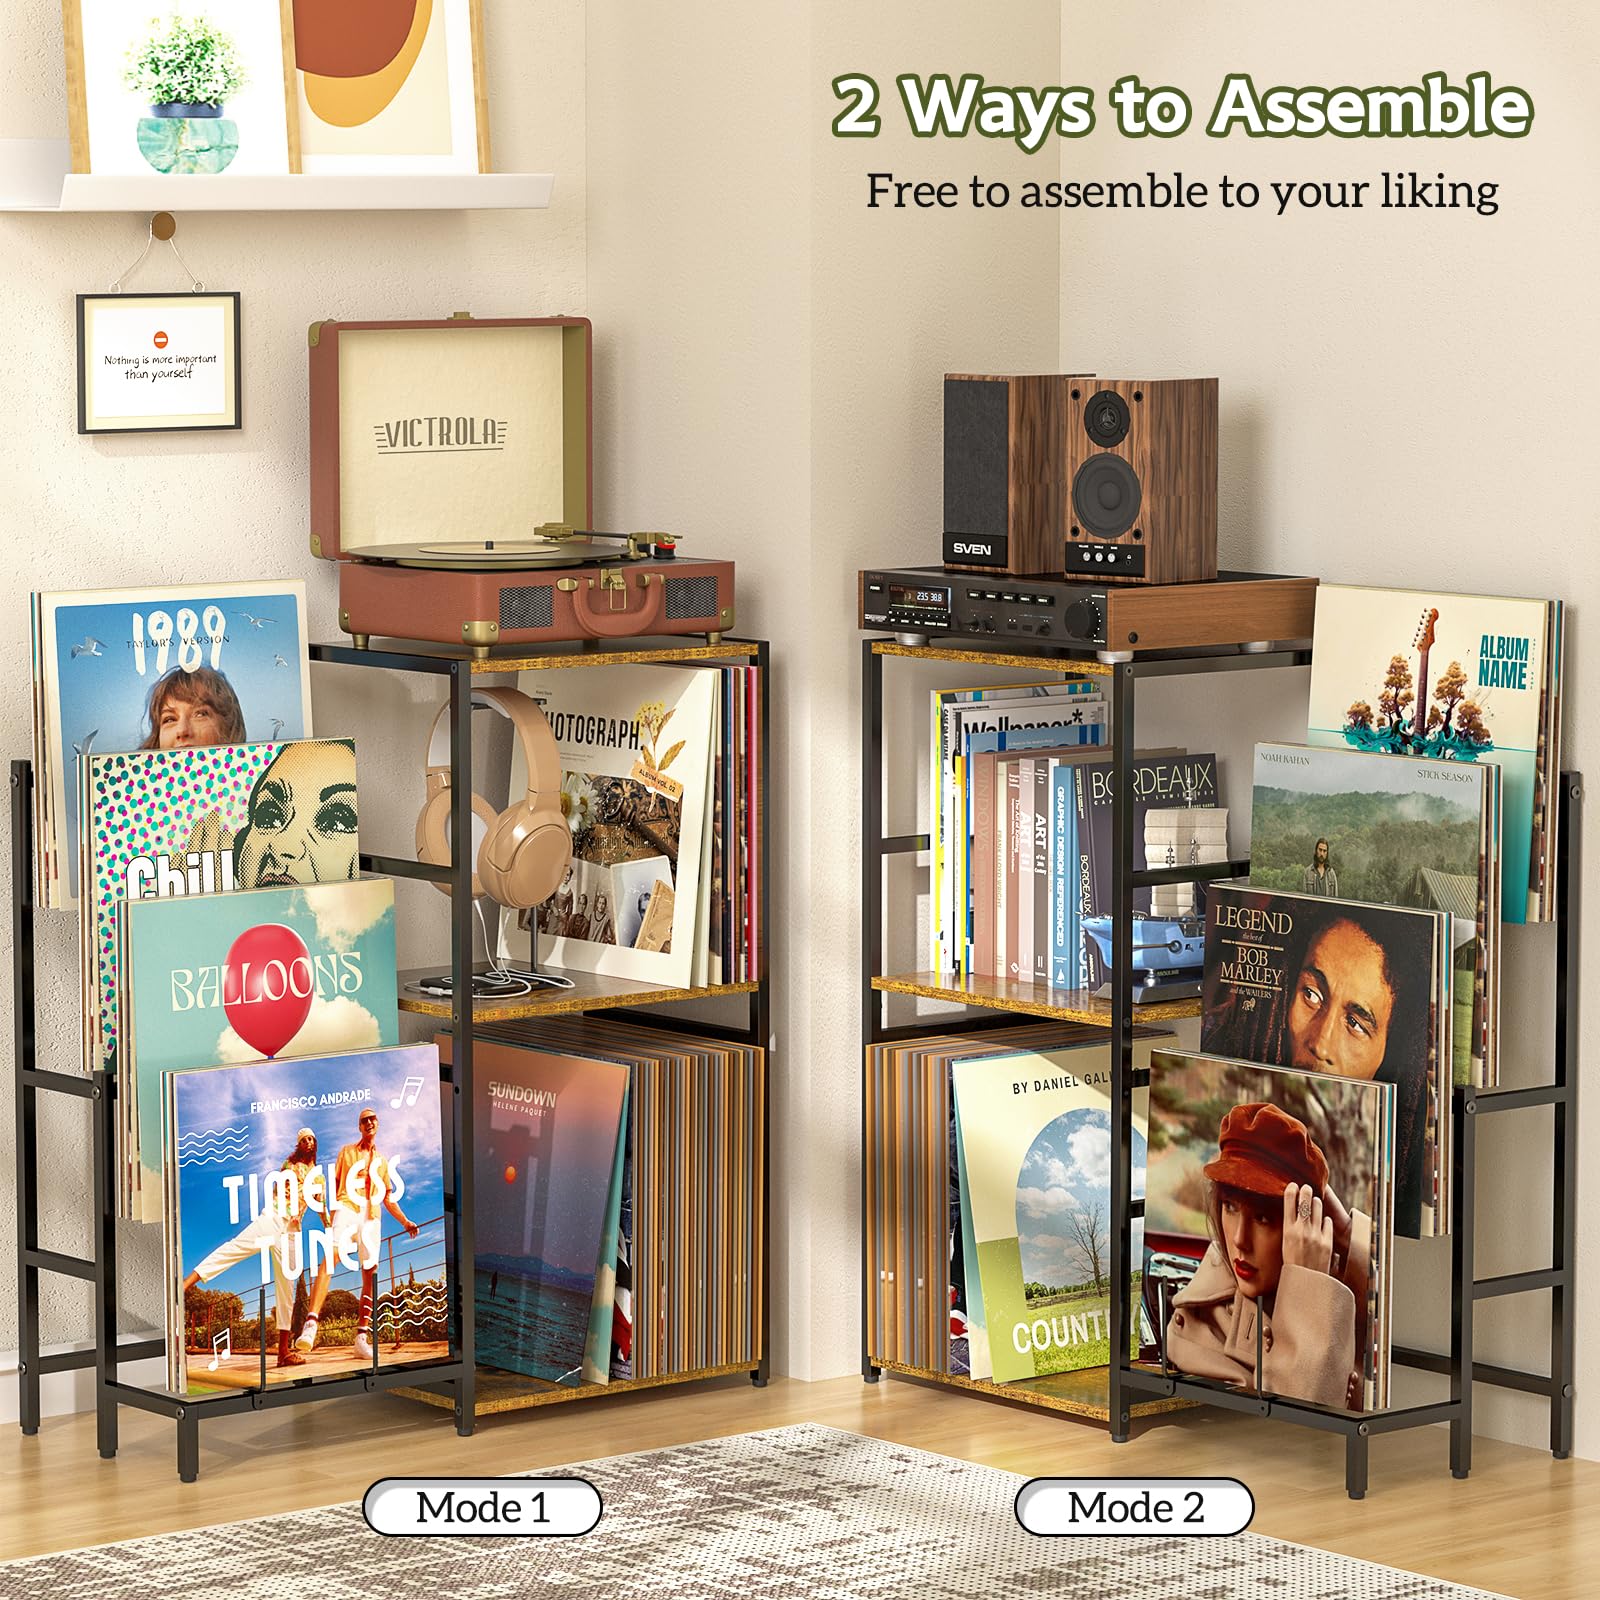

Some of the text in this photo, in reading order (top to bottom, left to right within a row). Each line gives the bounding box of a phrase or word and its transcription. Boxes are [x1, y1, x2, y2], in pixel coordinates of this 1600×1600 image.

[104, 354, 217, 369] Nothing is more important
[124, 363, 195, 383] than yourself
[384, 416, 497, 448] VICTROLA
[953, 542, 992, 556] SVEN
[126, 634, 230, 649] TAYLOR'S VERSION
[132, 605, 227, 676] 1989
[1479, 634, 1529, 661] ALBUM
[1478, 659, 1528, 690] NAME
[545, 711, 644, 751] OTOGRAPH.
[1260, 752, 1310, 766] NOAH KAHAN
[1417, 769, 1473, 783] STICK SEASON
[1056, 786, 1065, 834] GRAPHIC
[1035, 812, 1047, 850] ART
[1056, 836, 1065, 876] DESIGN
[125, 848, 236, 899] Chill
[1080, 855, 1092, 914] BORDEAUX
[1056, 877, 1065, 947] REFERENCED
[1214, 904, 1293, 935] LEGEND
[1237, 946, 1268, 967] BOB
[171, 951, 363, 1012] BALLOONS
[1220, 961, 1282, 986] MARLEY
[488, 1081, 557, 1108] SUNDOWN
[1012, 1081, 1028, 1095] BY
[1034, 1075, 1079, 1092] DANIEL
[250, 1088, 371, 1114] FRANCISCO ANDRADE
[222, 1154, 405, 1225] TIMELESS
[254, 1224, 381, 1285] TUNES
[1012, 1302, 1139, 1354] COUNTY
